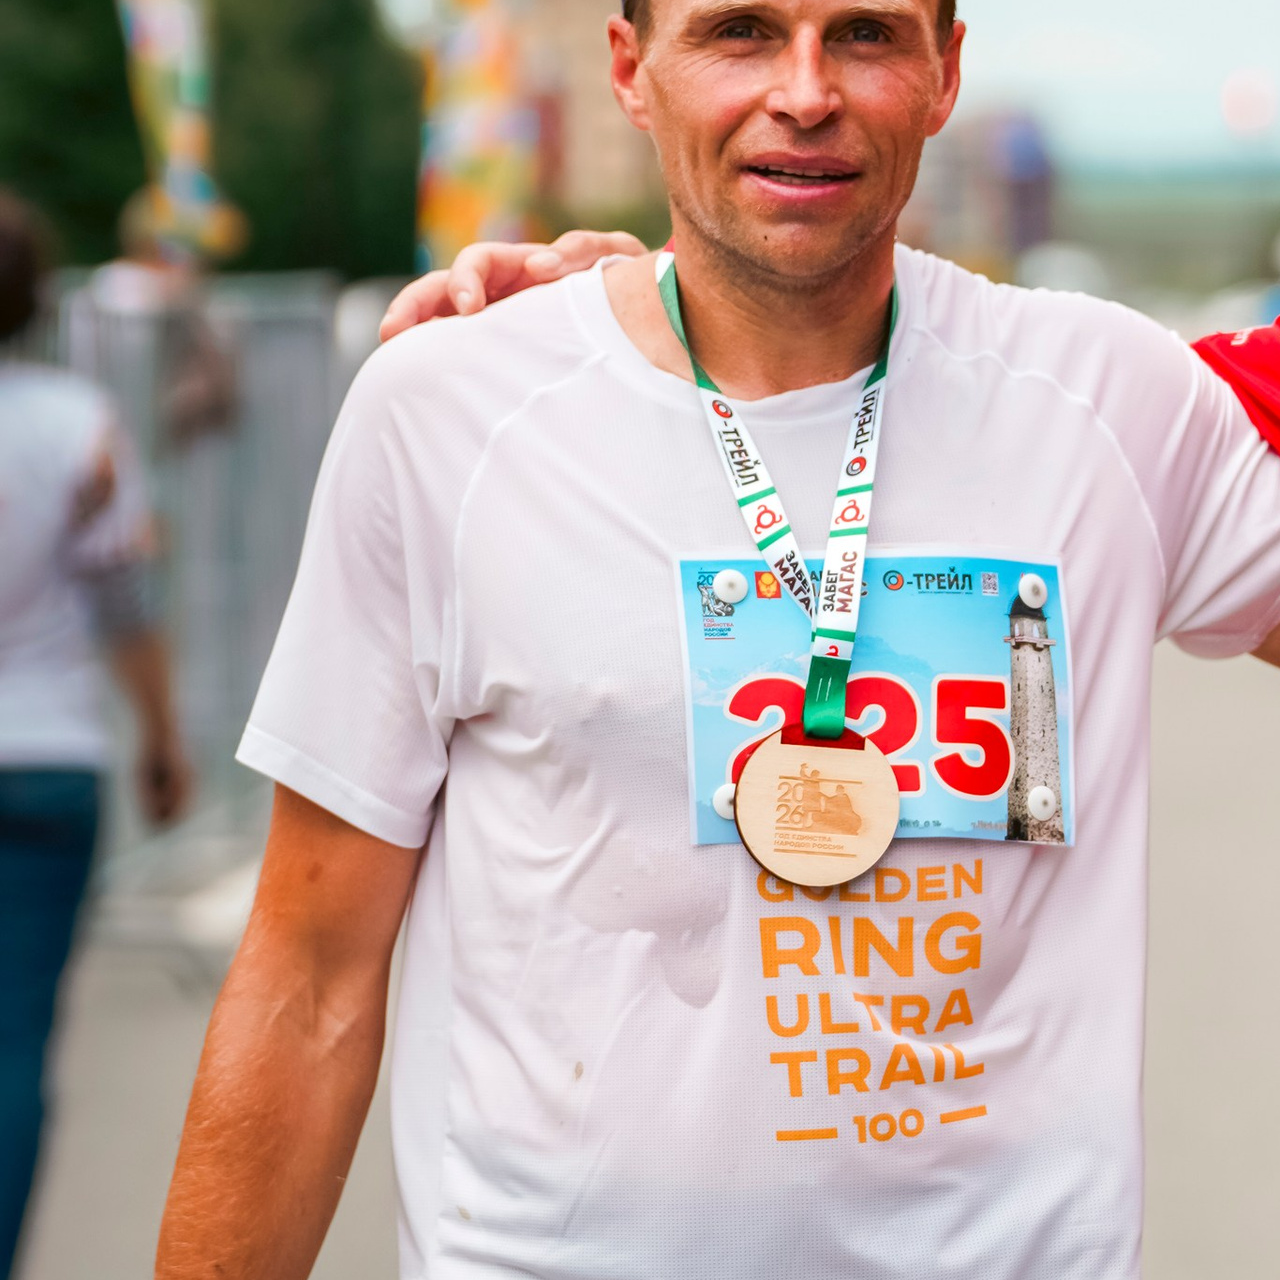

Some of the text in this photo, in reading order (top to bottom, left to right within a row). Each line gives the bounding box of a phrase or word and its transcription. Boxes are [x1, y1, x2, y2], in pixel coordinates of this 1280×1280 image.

[774, 557, 813, 619] МАГА
[823, 570, 838, 612] ЗАБЕГ
[836, 551, 858, 613] МАГАС
[776, 803, 804, 824] 26
[777, 781, 804, 803] 20
[756, 859, 983, 903] GLDEN
[759, 911, 982, 978] RING
[765, 988, 974, 1038] ULTRA
[769, 1043, 985, 1098] TRAIL
[853, 1108, 925, 1143] 100
